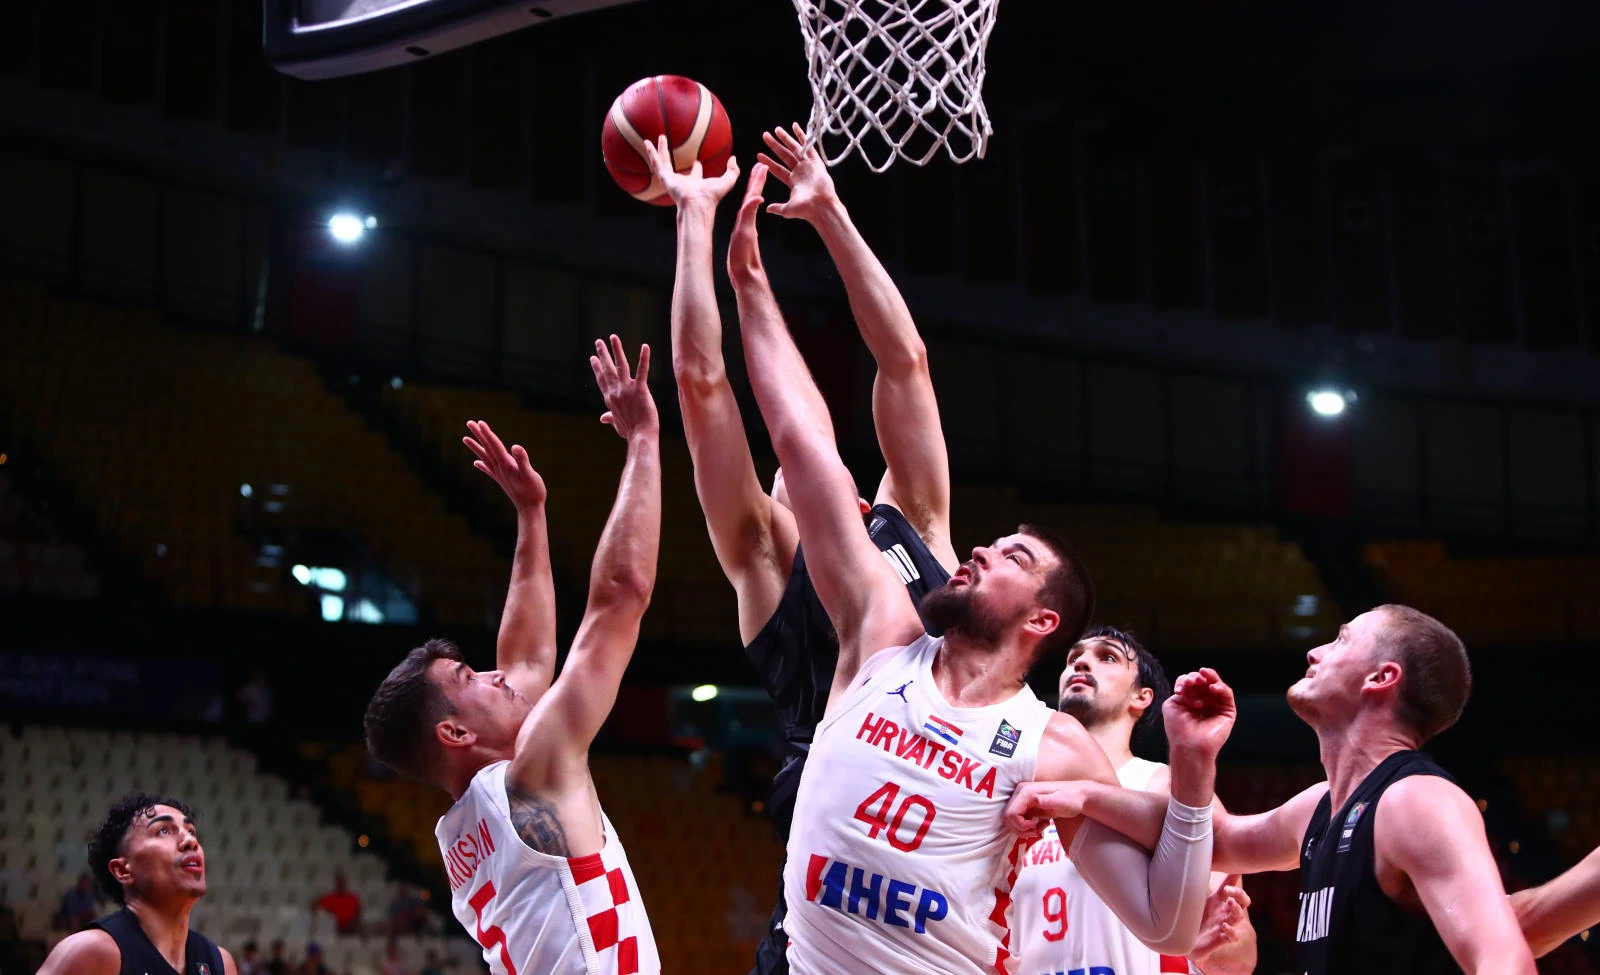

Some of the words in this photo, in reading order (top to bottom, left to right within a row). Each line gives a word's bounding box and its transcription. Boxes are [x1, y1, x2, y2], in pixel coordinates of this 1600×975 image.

[856, 712, 997, 799] HRVATSKA
[996, 738, 1013, 750] FIBA
[854, 781, 937, 853] 40
[468, 880, 517, 975] 5
[847, 867, 949, 934] HEP
[1042, 887, 1069, 942] 9
